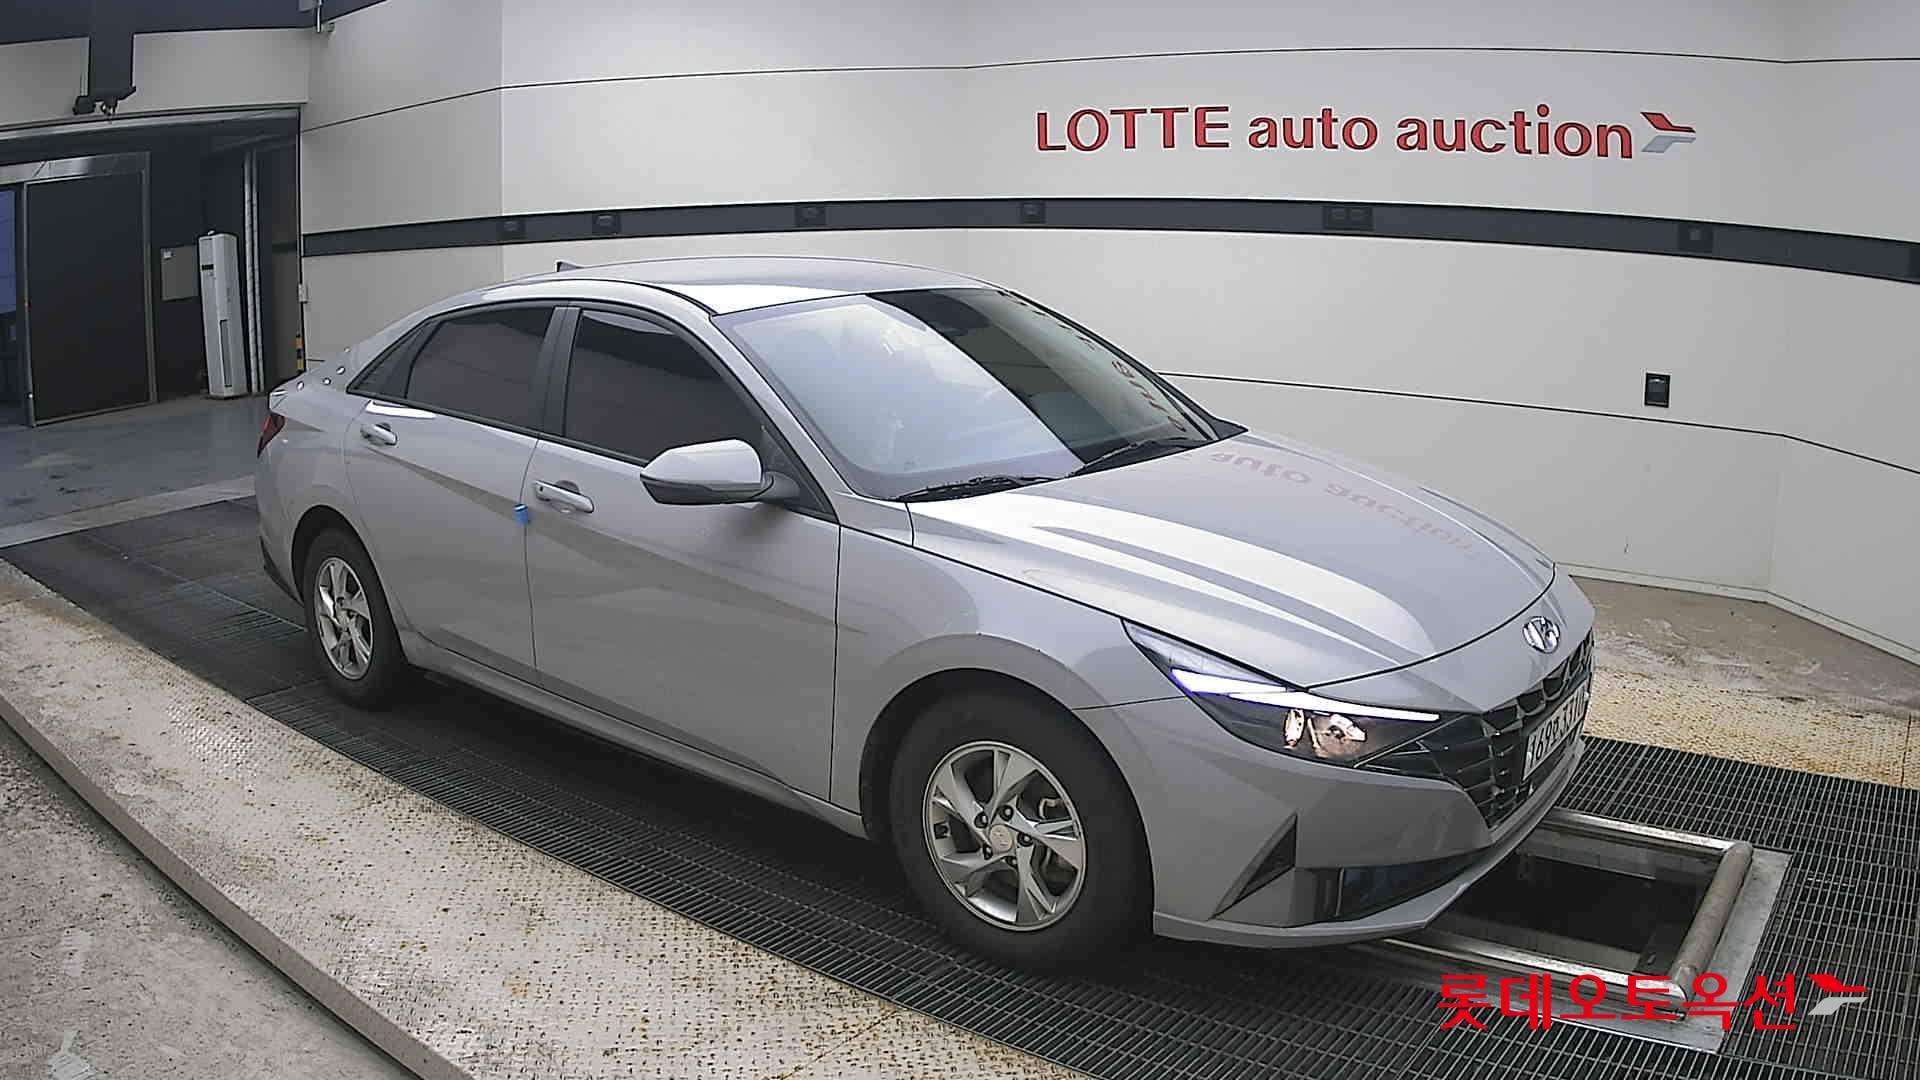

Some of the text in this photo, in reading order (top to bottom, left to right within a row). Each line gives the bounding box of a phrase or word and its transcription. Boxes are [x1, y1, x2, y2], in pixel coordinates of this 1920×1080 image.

[1036, 103, 1634, 159] LOTTE auto auction
